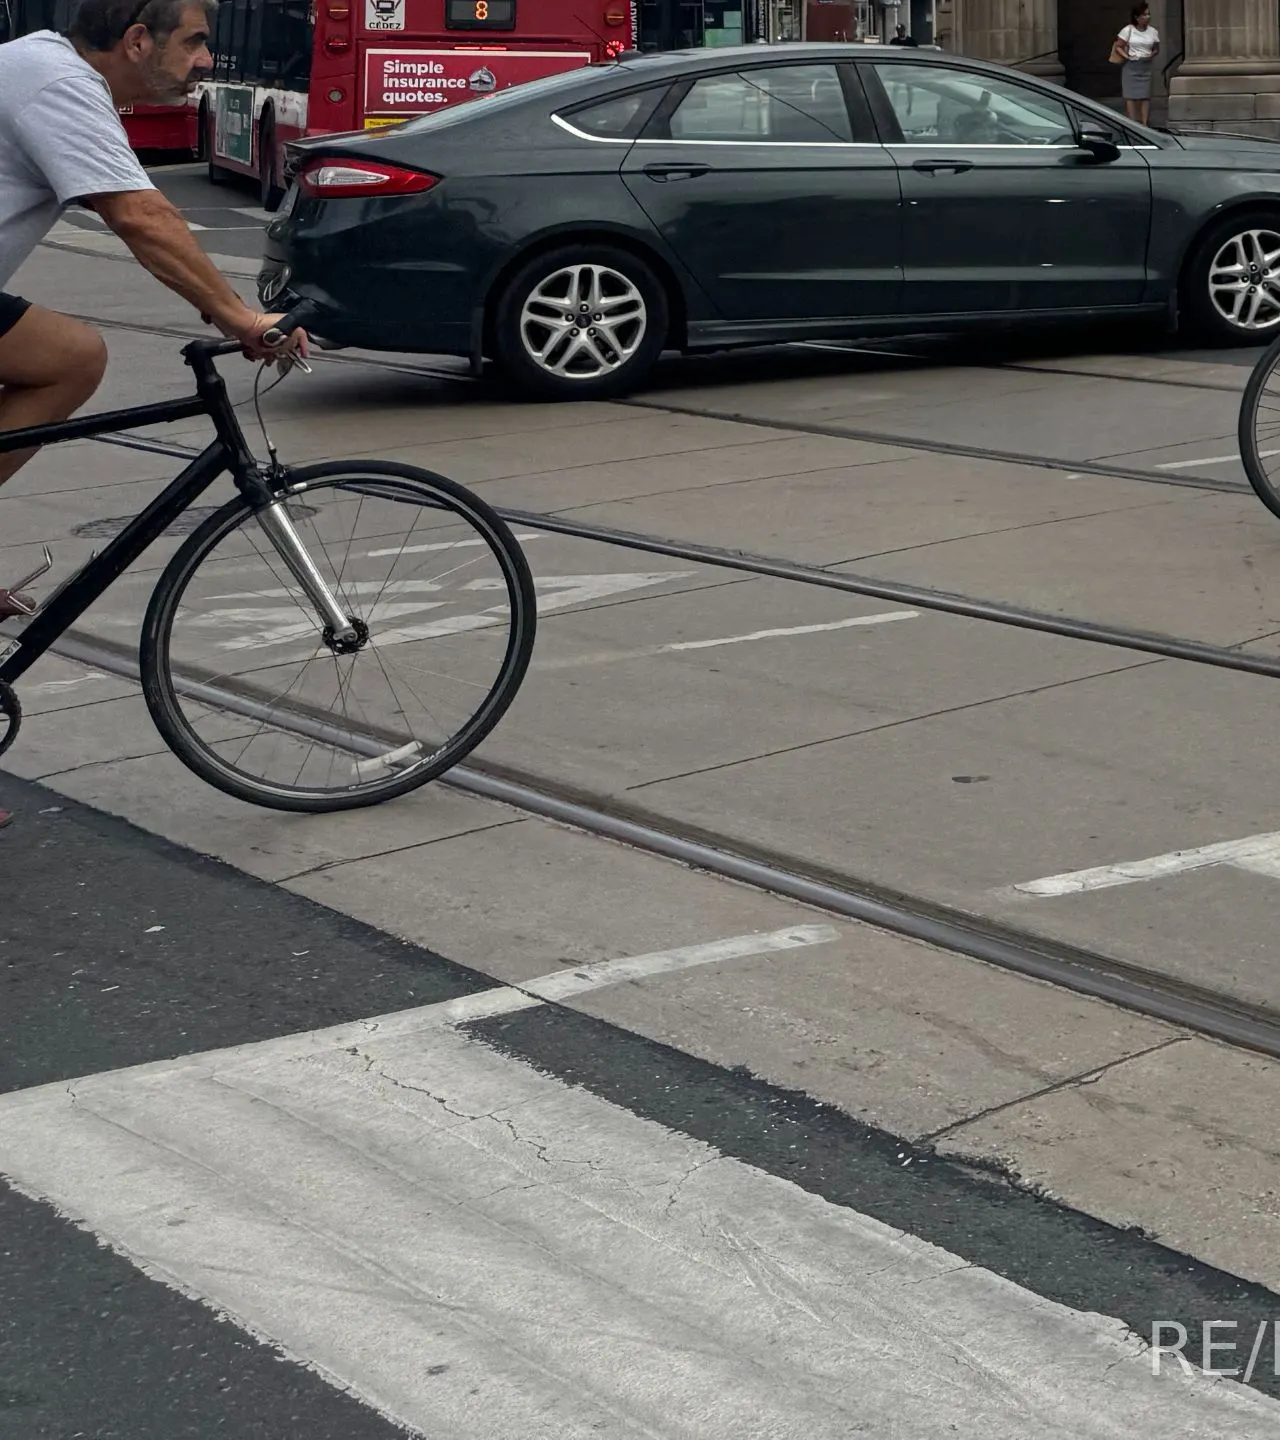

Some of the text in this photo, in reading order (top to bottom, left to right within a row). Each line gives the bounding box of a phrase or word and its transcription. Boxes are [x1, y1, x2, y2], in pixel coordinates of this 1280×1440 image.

[475, 0, 488, 20] 8
[383, 60, 444, 75] Simple
[383, 74, 466, 89] insurance
[382, 90, 448, 104] quotes.
